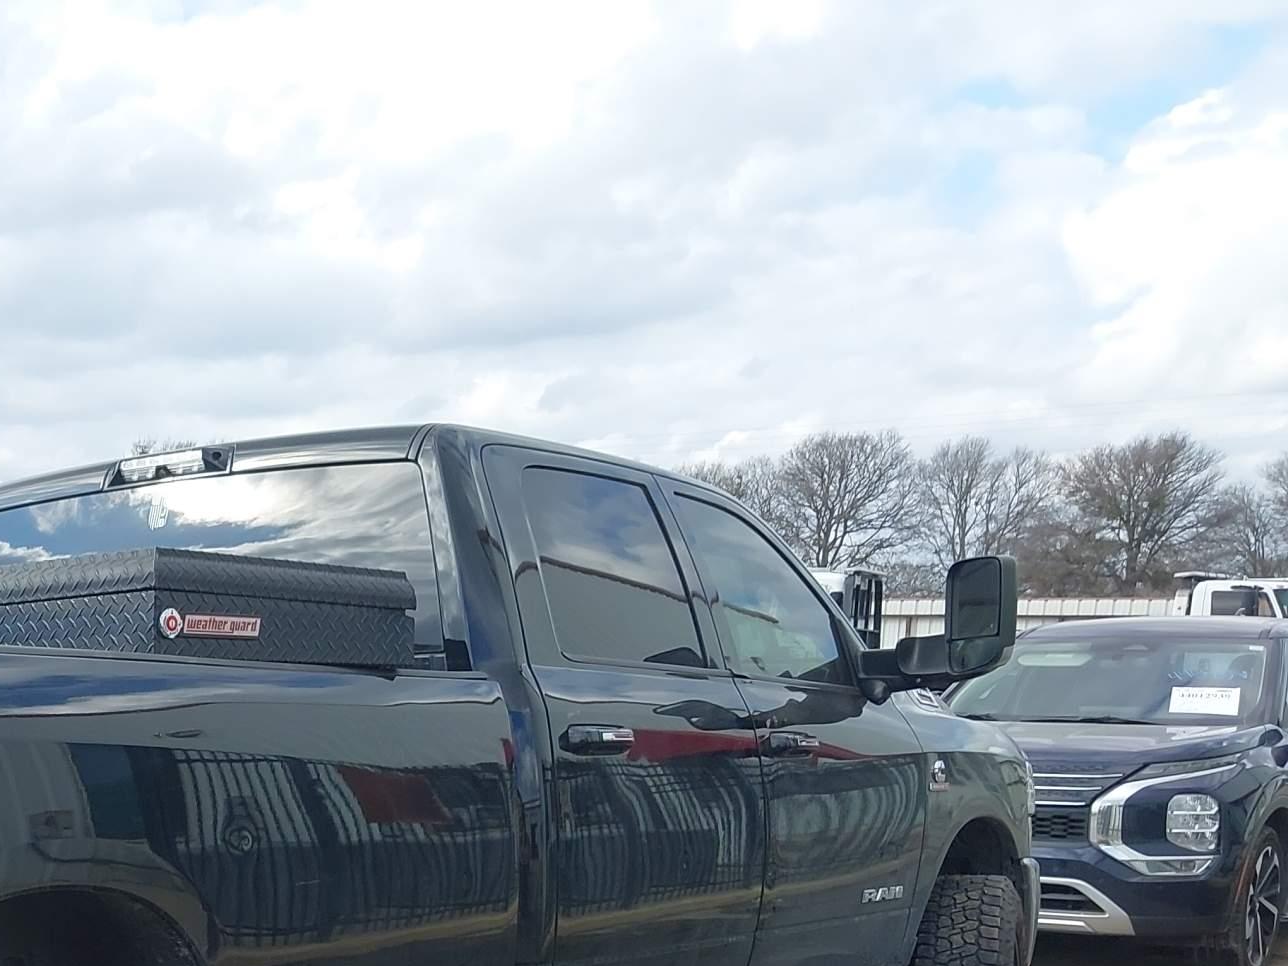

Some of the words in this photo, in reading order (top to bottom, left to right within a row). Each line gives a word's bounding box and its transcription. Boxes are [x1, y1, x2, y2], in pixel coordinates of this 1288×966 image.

[187, 618, 229, 630] weather
[230, 619, 258, 632] guard
[862, 885, 903, 904] RAM
